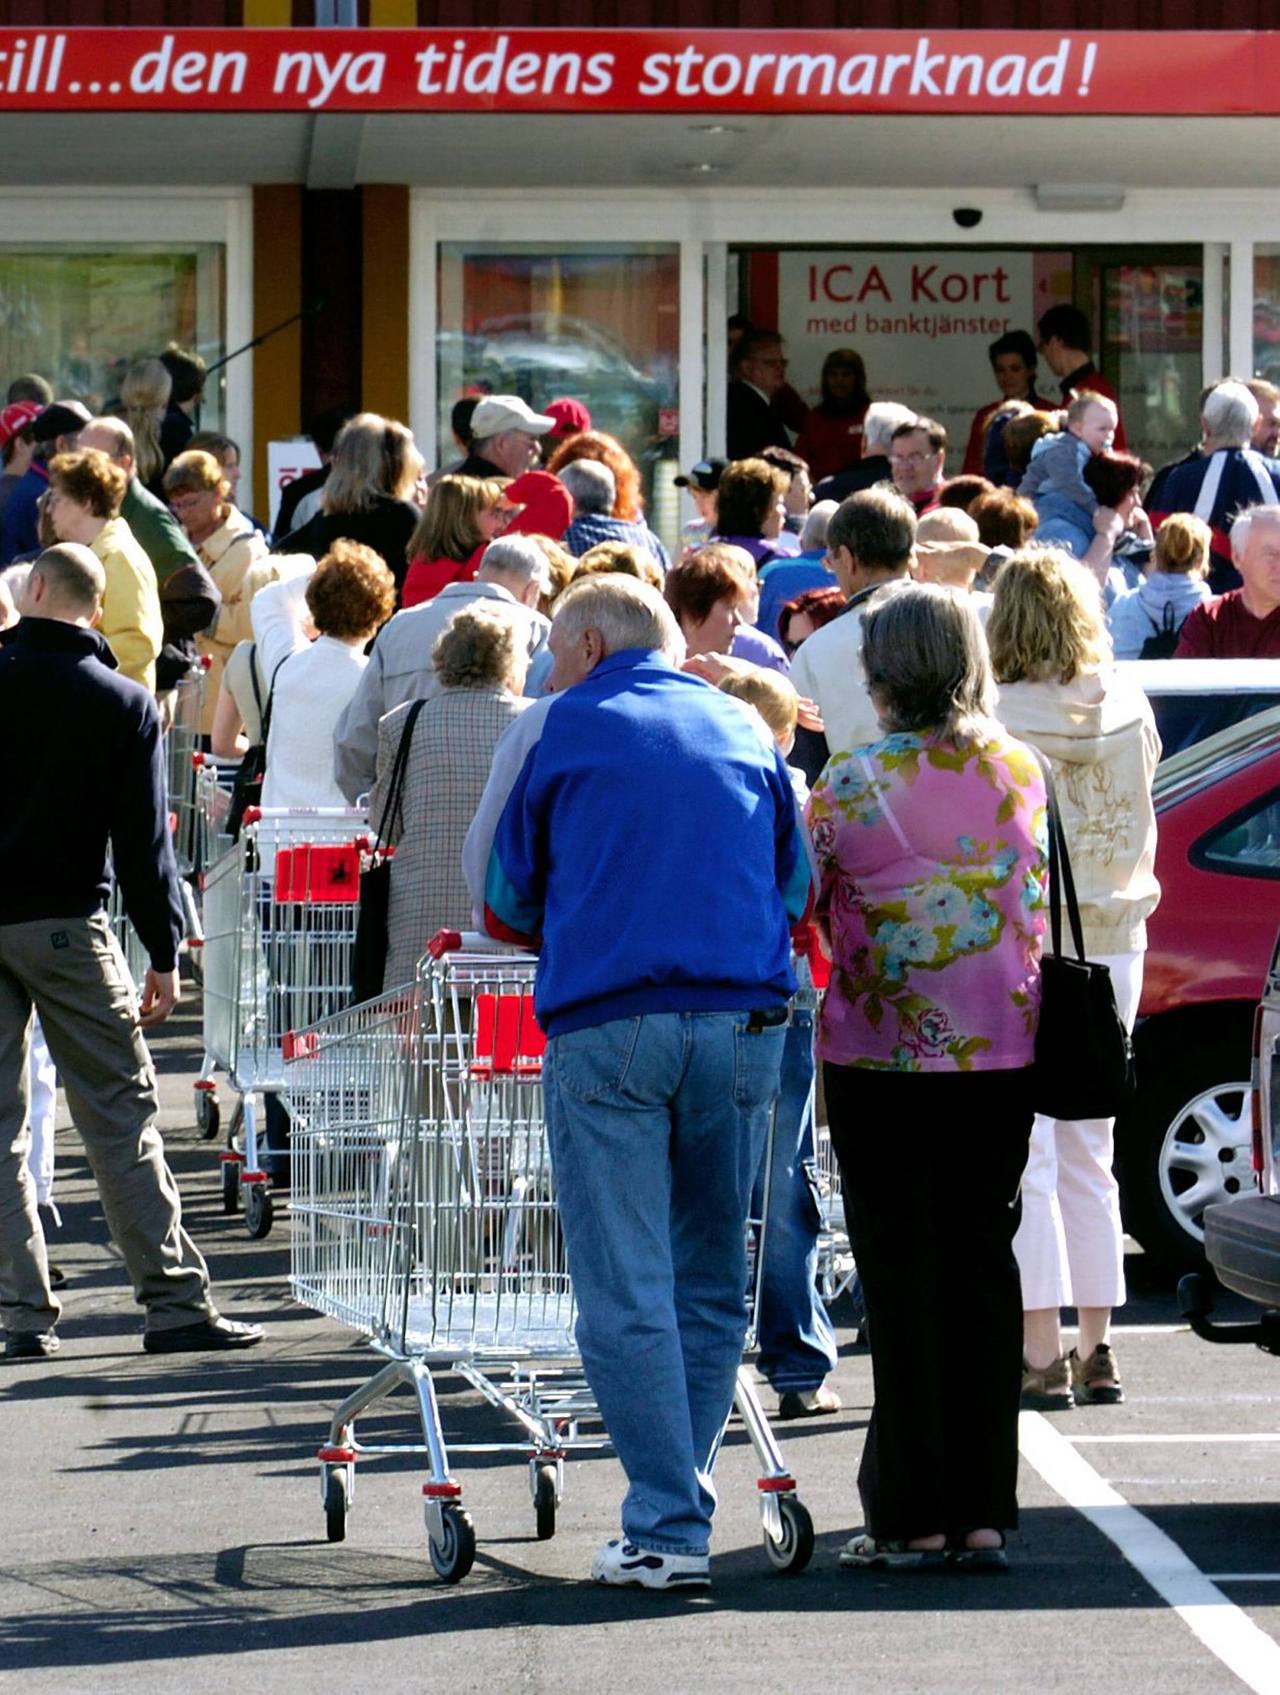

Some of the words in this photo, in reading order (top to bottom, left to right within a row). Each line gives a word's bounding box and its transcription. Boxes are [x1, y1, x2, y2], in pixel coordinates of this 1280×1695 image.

[273, 51, 386, 108] nya
[415, 36, 613, 95] tidens
[638, 38, 1097, 96] stormarknad!
[809, 264, 892, 303] ICA
[911, 265, 1010, 303] Kort
[807, 313, 858, 333] med
[866, 312, 1010, 338] banktjänster
